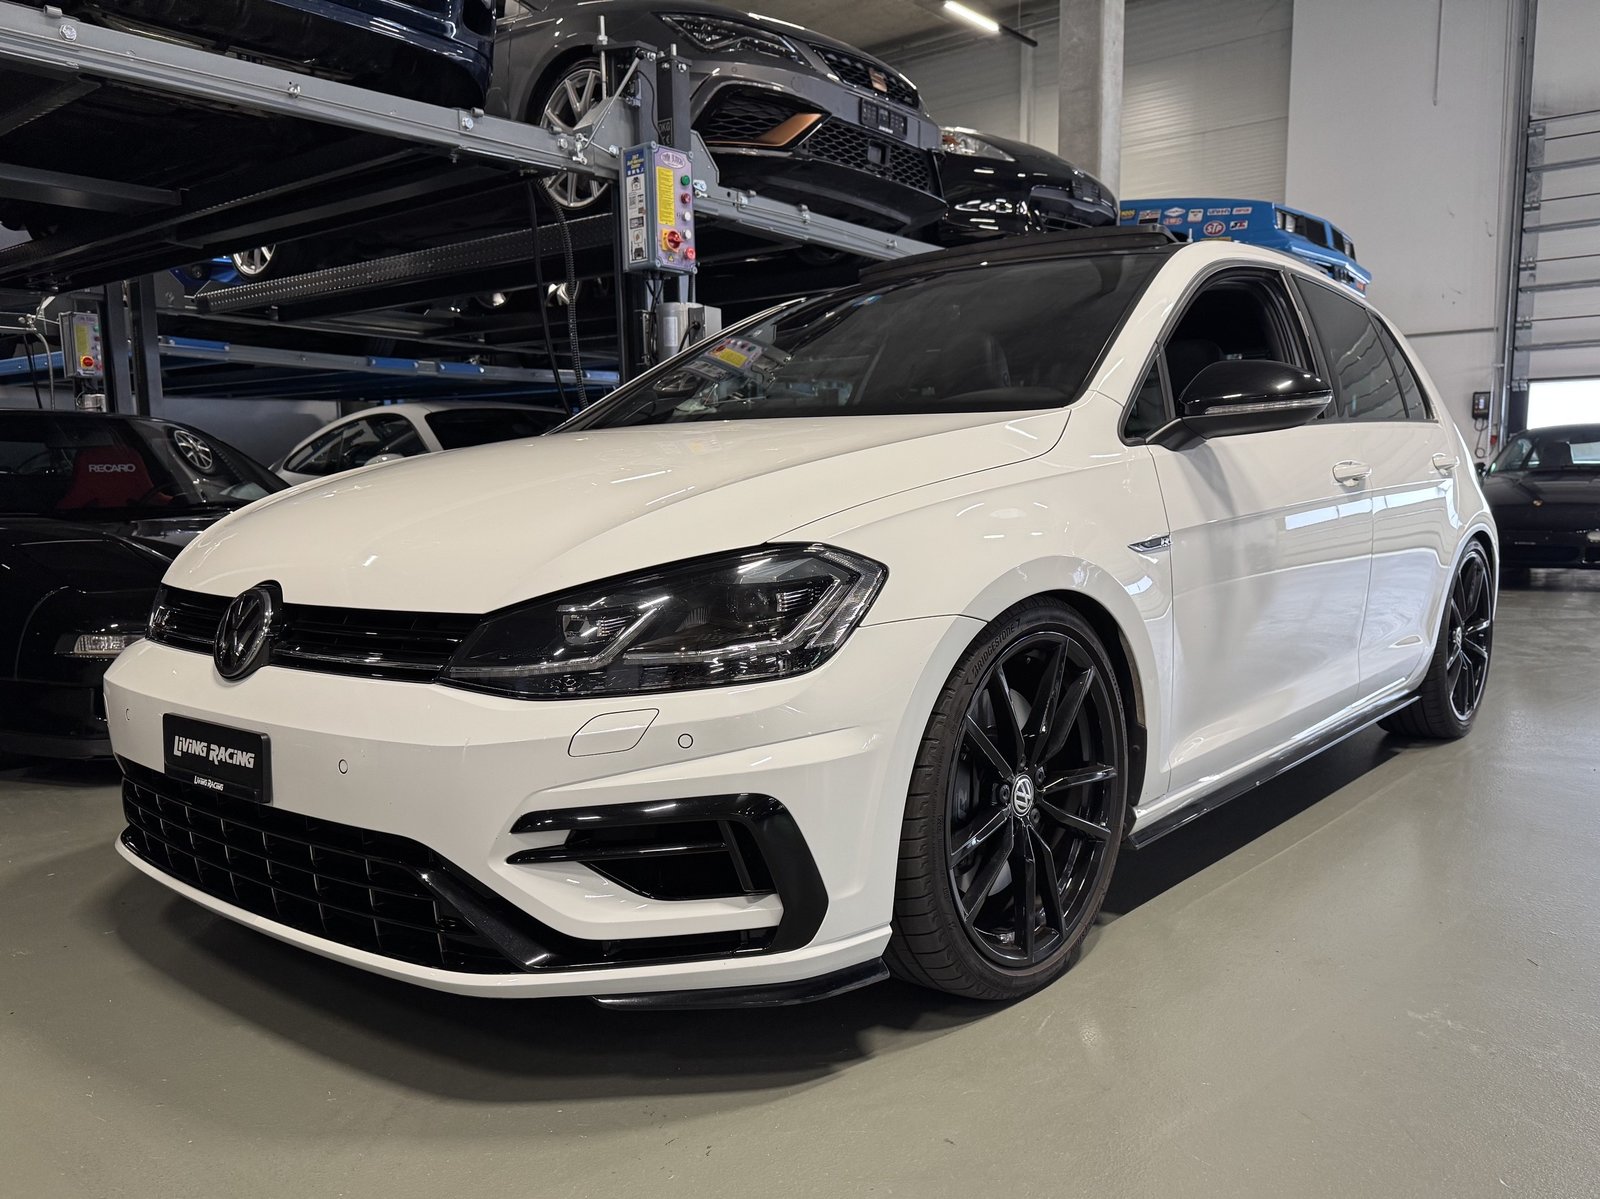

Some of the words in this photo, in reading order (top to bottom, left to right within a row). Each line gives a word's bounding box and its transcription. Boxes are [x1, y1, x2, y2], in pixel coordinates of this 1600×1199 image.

[1207, 222, 1223, 234] STP
[88, 463, 136, 473] RECARO
[972, 622, 1016, 678] BRIDGESTONE
